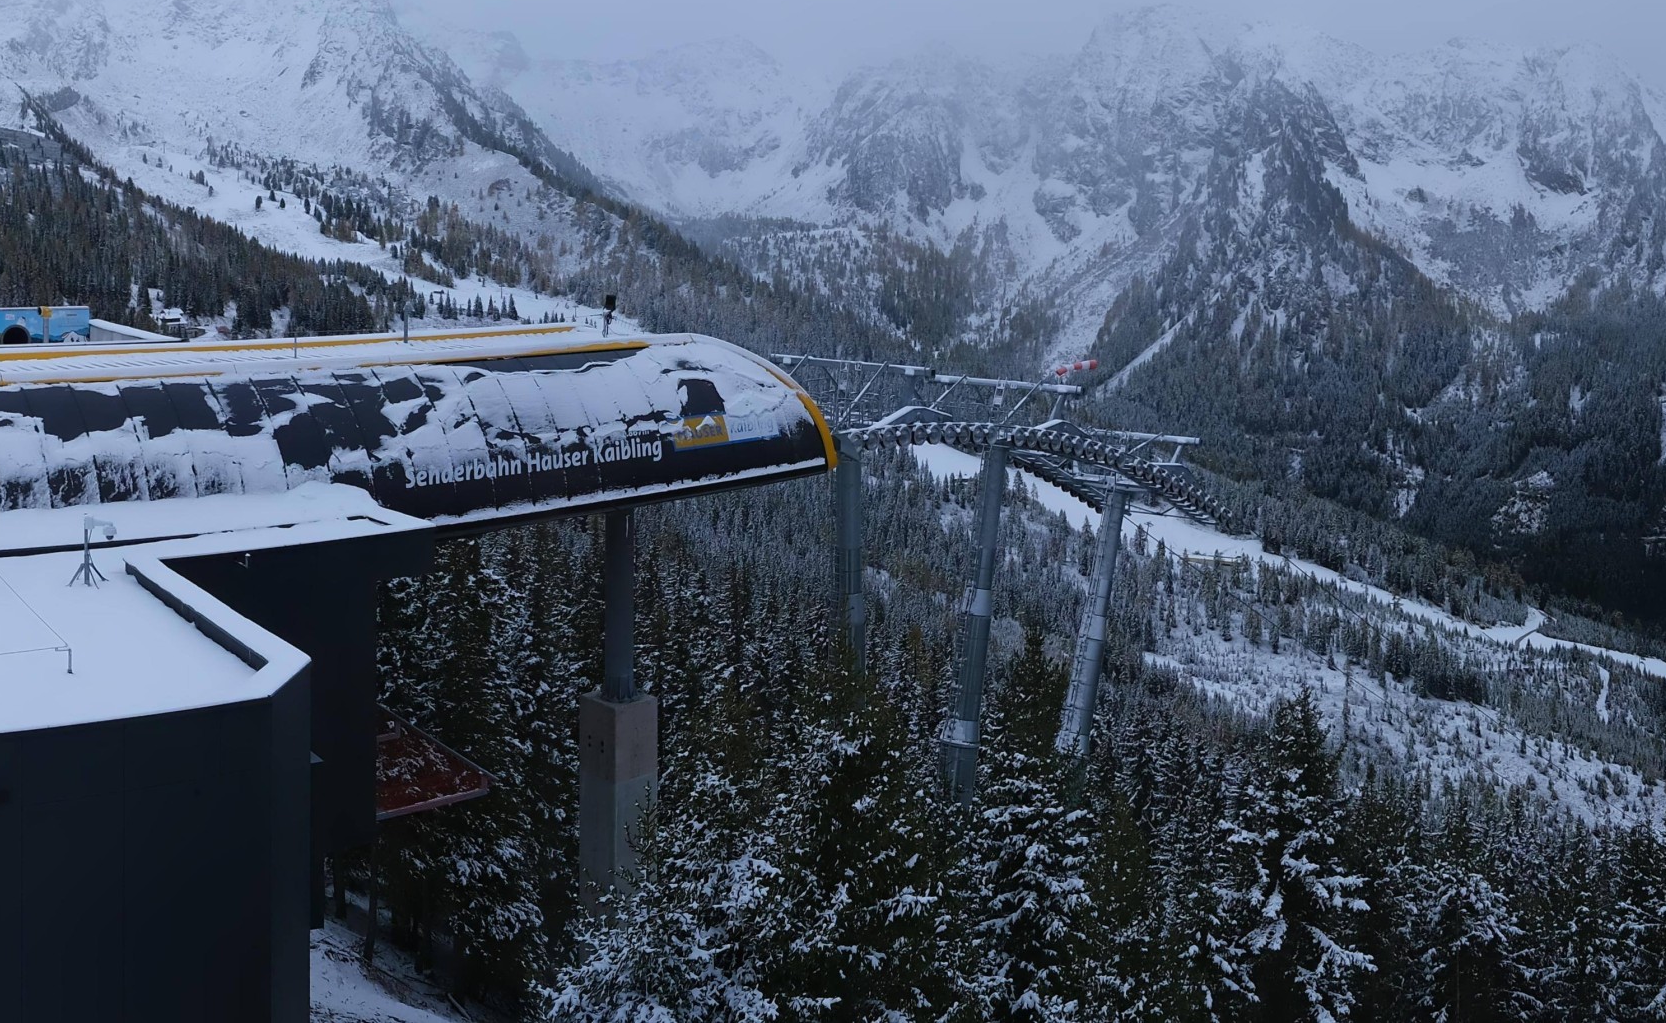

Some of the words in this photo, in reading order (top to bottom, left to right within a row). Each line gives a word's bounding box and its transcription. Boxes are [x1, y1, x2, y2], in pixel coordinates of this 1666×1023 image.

[405, 455, 522, 488] Senderbahn
[527, 449, 589, 473] Hauser
[593, 437, 662, 463] Kaibling
